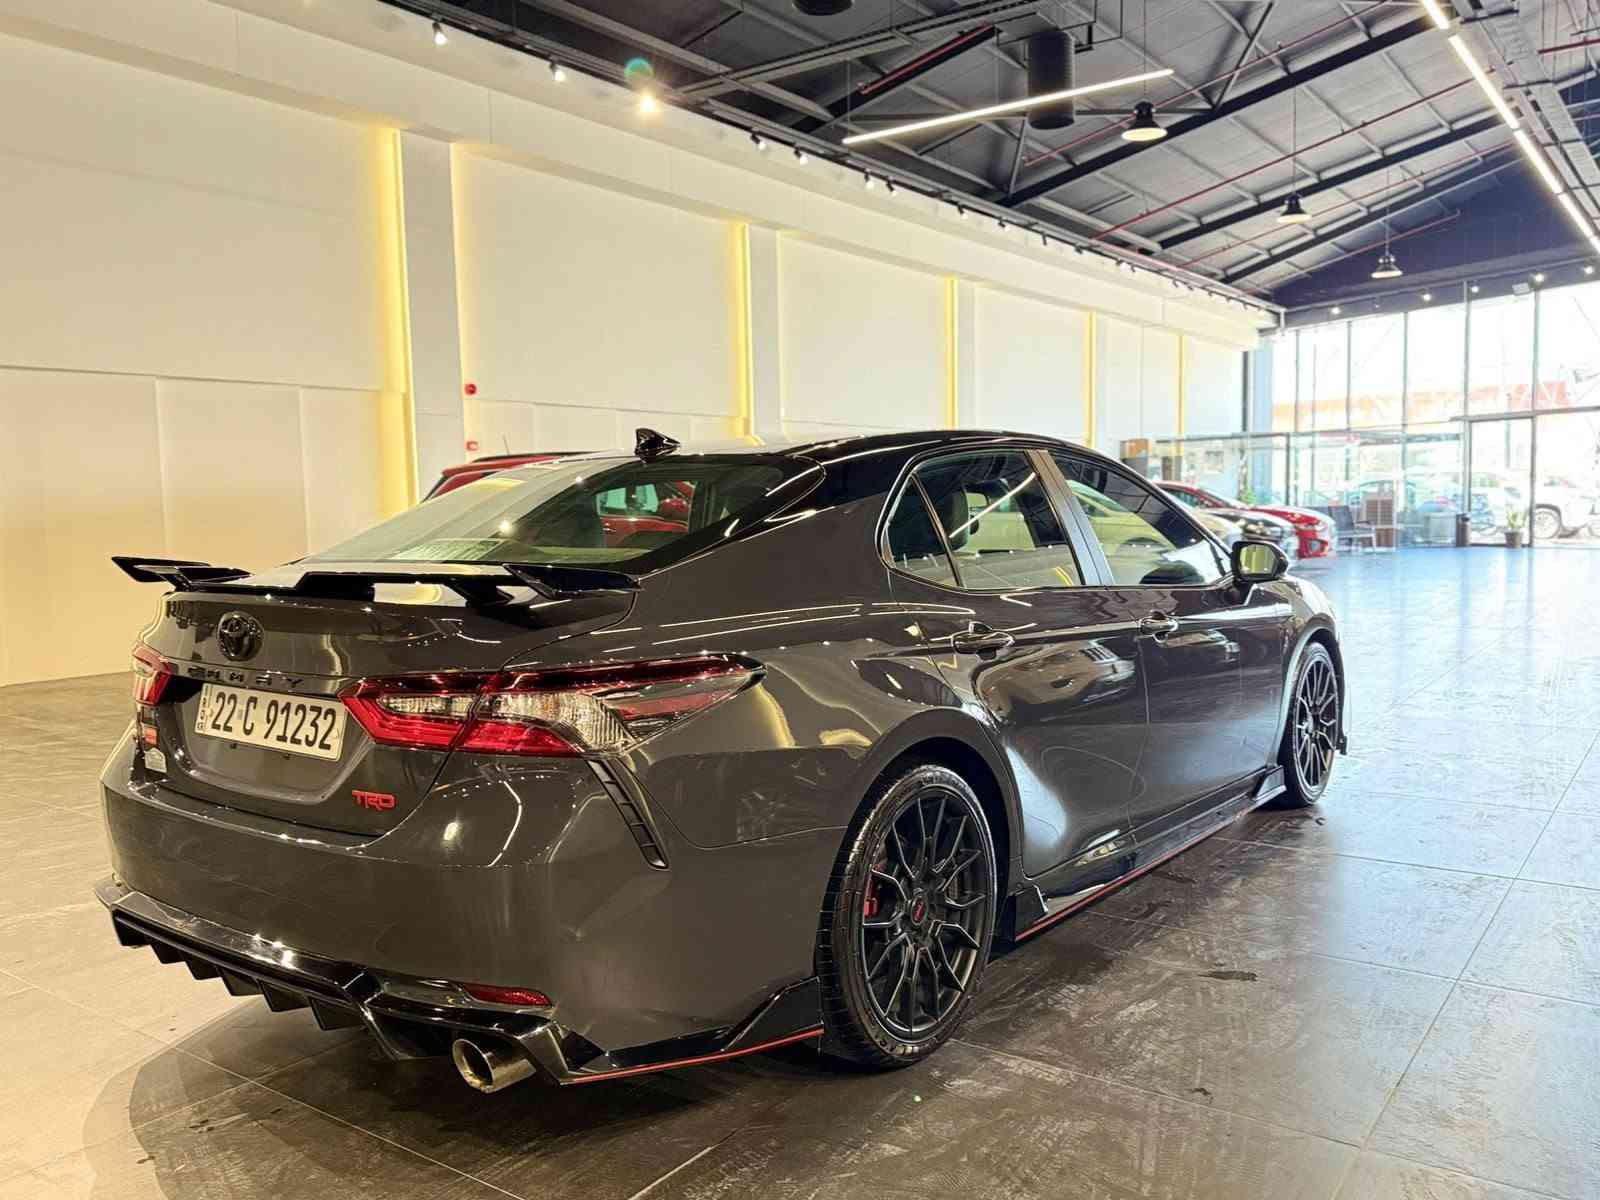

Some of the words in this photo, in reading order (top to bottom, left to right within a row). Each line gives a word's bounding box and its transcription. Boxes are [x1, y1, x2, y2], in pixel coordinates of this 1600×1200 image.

[211, 691, 238, 733] 22
[243, 696, 259, 736] C
[263, 699, 337, 751] 91232
[351, 789, 396, 811] TRD
